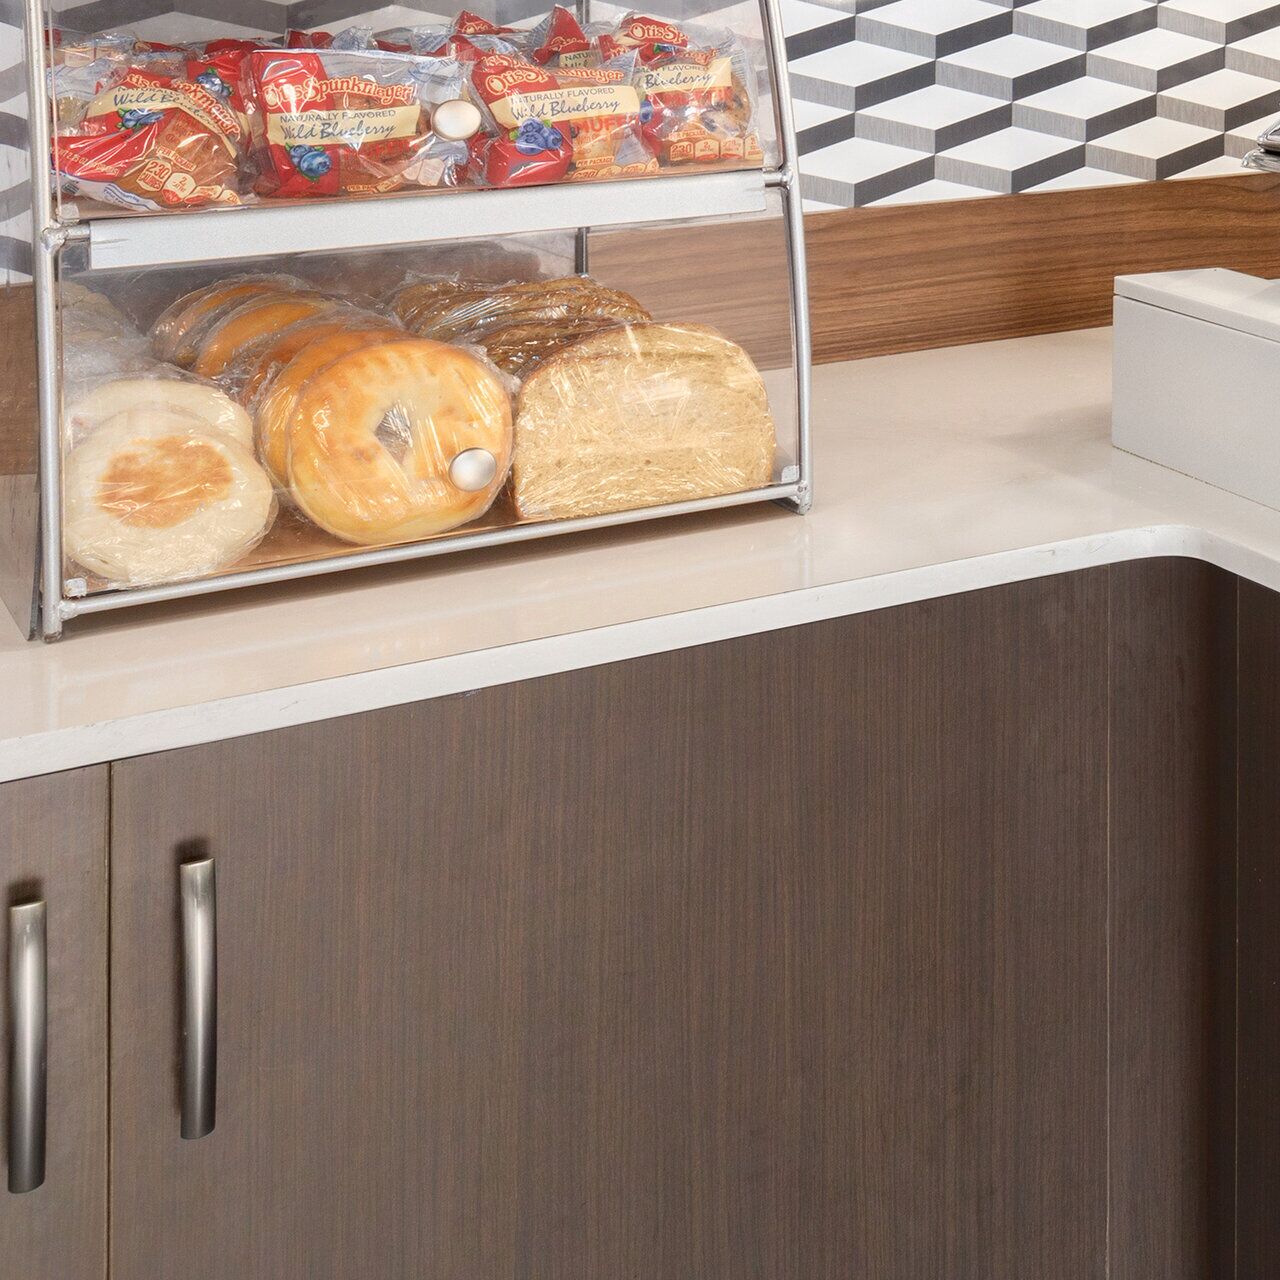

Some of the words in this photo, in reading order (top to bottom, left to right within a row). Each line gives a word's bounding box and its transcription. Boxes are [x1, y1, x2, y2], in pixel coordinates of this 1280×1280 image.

[629, 22, 664, 40] Otis
[302, 75, 415, 105] Spunkmeyer
[485, 70, 526, 96] Otis
[644, 73, 713, 91] Blueberry
[113, 92, 158, 107] Wild
[566, 87, 616, 98] FLAVORED
[511, 106, 546, 121] Wild
[549, 96, 621, 117] Blueberry
[281, 123, 318, 141] Wild
[319, 120, 397, 140] Blueberry
[672, 143, 692, 154] 230
[147, 160, 171, 178] 230
